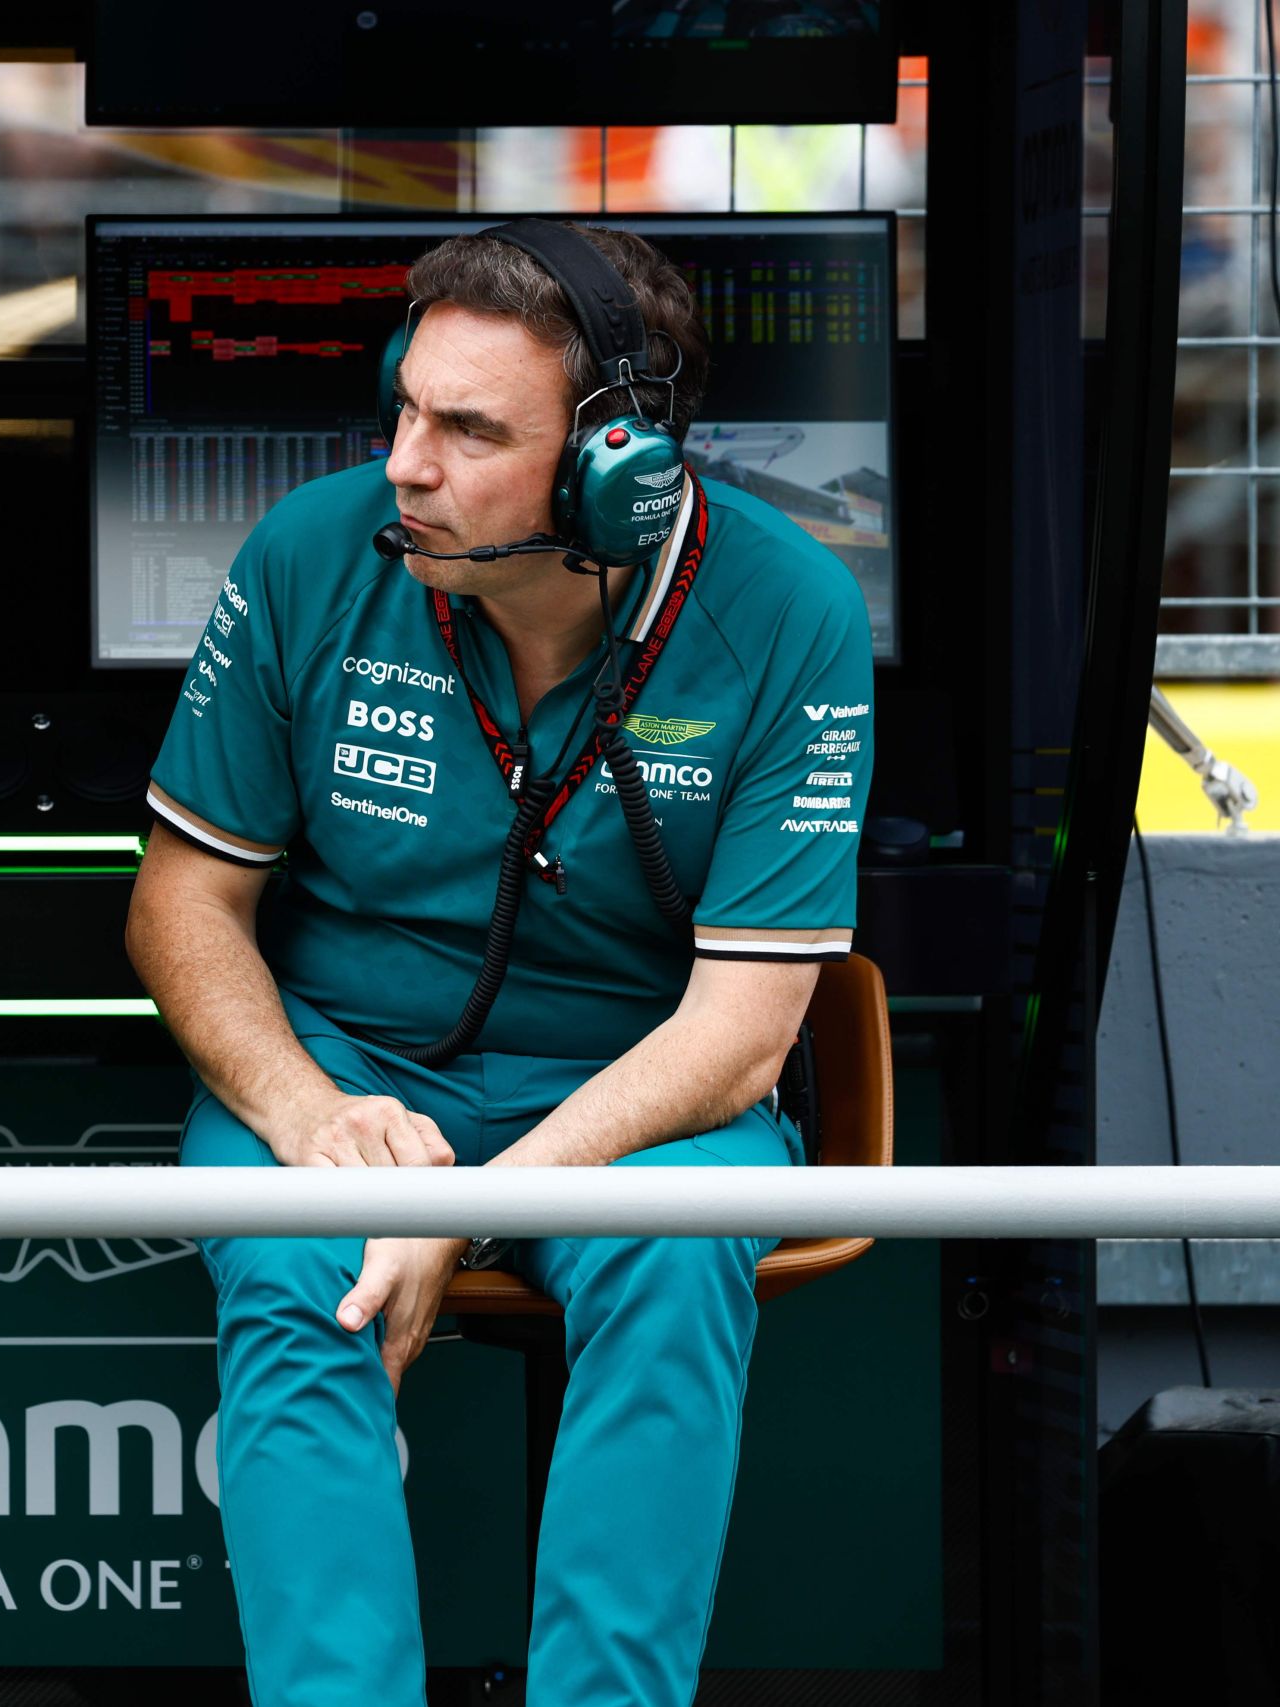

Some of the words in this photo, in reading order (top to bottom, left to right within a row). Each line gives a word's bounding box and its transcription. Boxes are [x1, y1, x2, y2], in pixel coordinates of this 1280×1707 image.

[632, 489, 682, 514] aramco
[638, 526, 671, 546] EPOS
[631, 637, 663, 685] LANE
[655, 589, 687, 640] 2024
[342, 656, 456, 695] cognizant
[346, 699, 435, 742] BOSS
[830, 704, 869, 719] Valvoline
[640, 721, 661, 730] ASTON
[660, 723, 687, 733] MARTIN
[821, 729, 856, 742] GIRARD
[806, 741, 862, 755] PERREGAUX
[335, 745, 435, 792] JCB
[511, 765, 524, 791] BOSS
[806, 771, 853, 787] PIRELLI
[680, 790, 710, 801] TEAM
[330, 791, 429, 828] SentinelOne
[780, 818, 859, 833] AVATRADE
